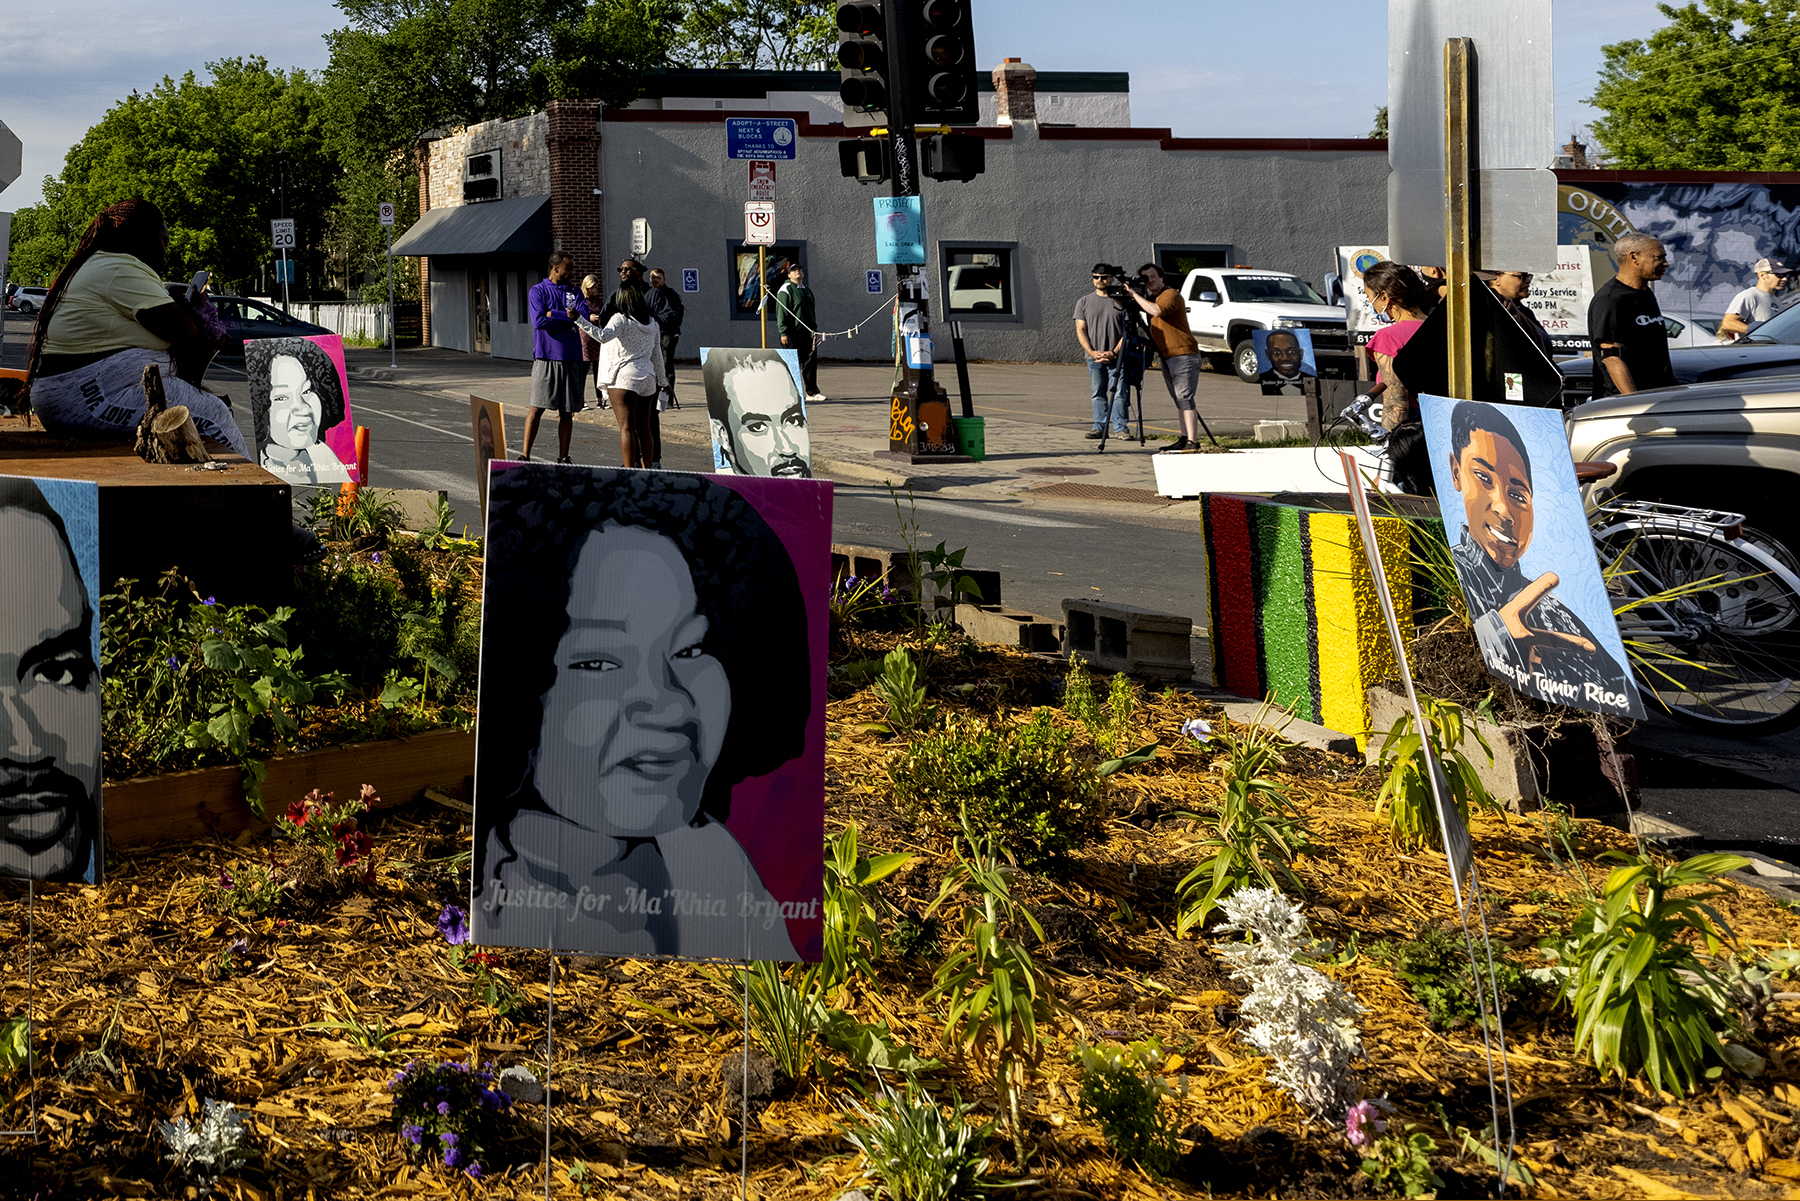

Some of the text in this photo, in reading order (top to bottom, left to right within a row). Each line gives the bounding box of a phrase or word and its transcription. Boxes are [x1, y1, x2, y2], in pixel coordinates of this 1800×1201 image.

[878, 198, 914, 210] PROTECT
[275, 234, 293, 245] 20
[1550, 287, 1577, 296] Service
[1526, 301, 1557, 310] 7:00 PM
[79, 378, 105, 413] LOVE
[98, 404, 137, 426] LOVE
[284, 464, 296, 476] for
[331, 462, 357, 474] Bryant
[1515, 664, 1531, 692] for
[1532, 671, 1579, 699] Tamir
[1583, 681, 1630, 708] Rice
[482, 878, 821, 930] Justice for Ma'Khia Bryant
